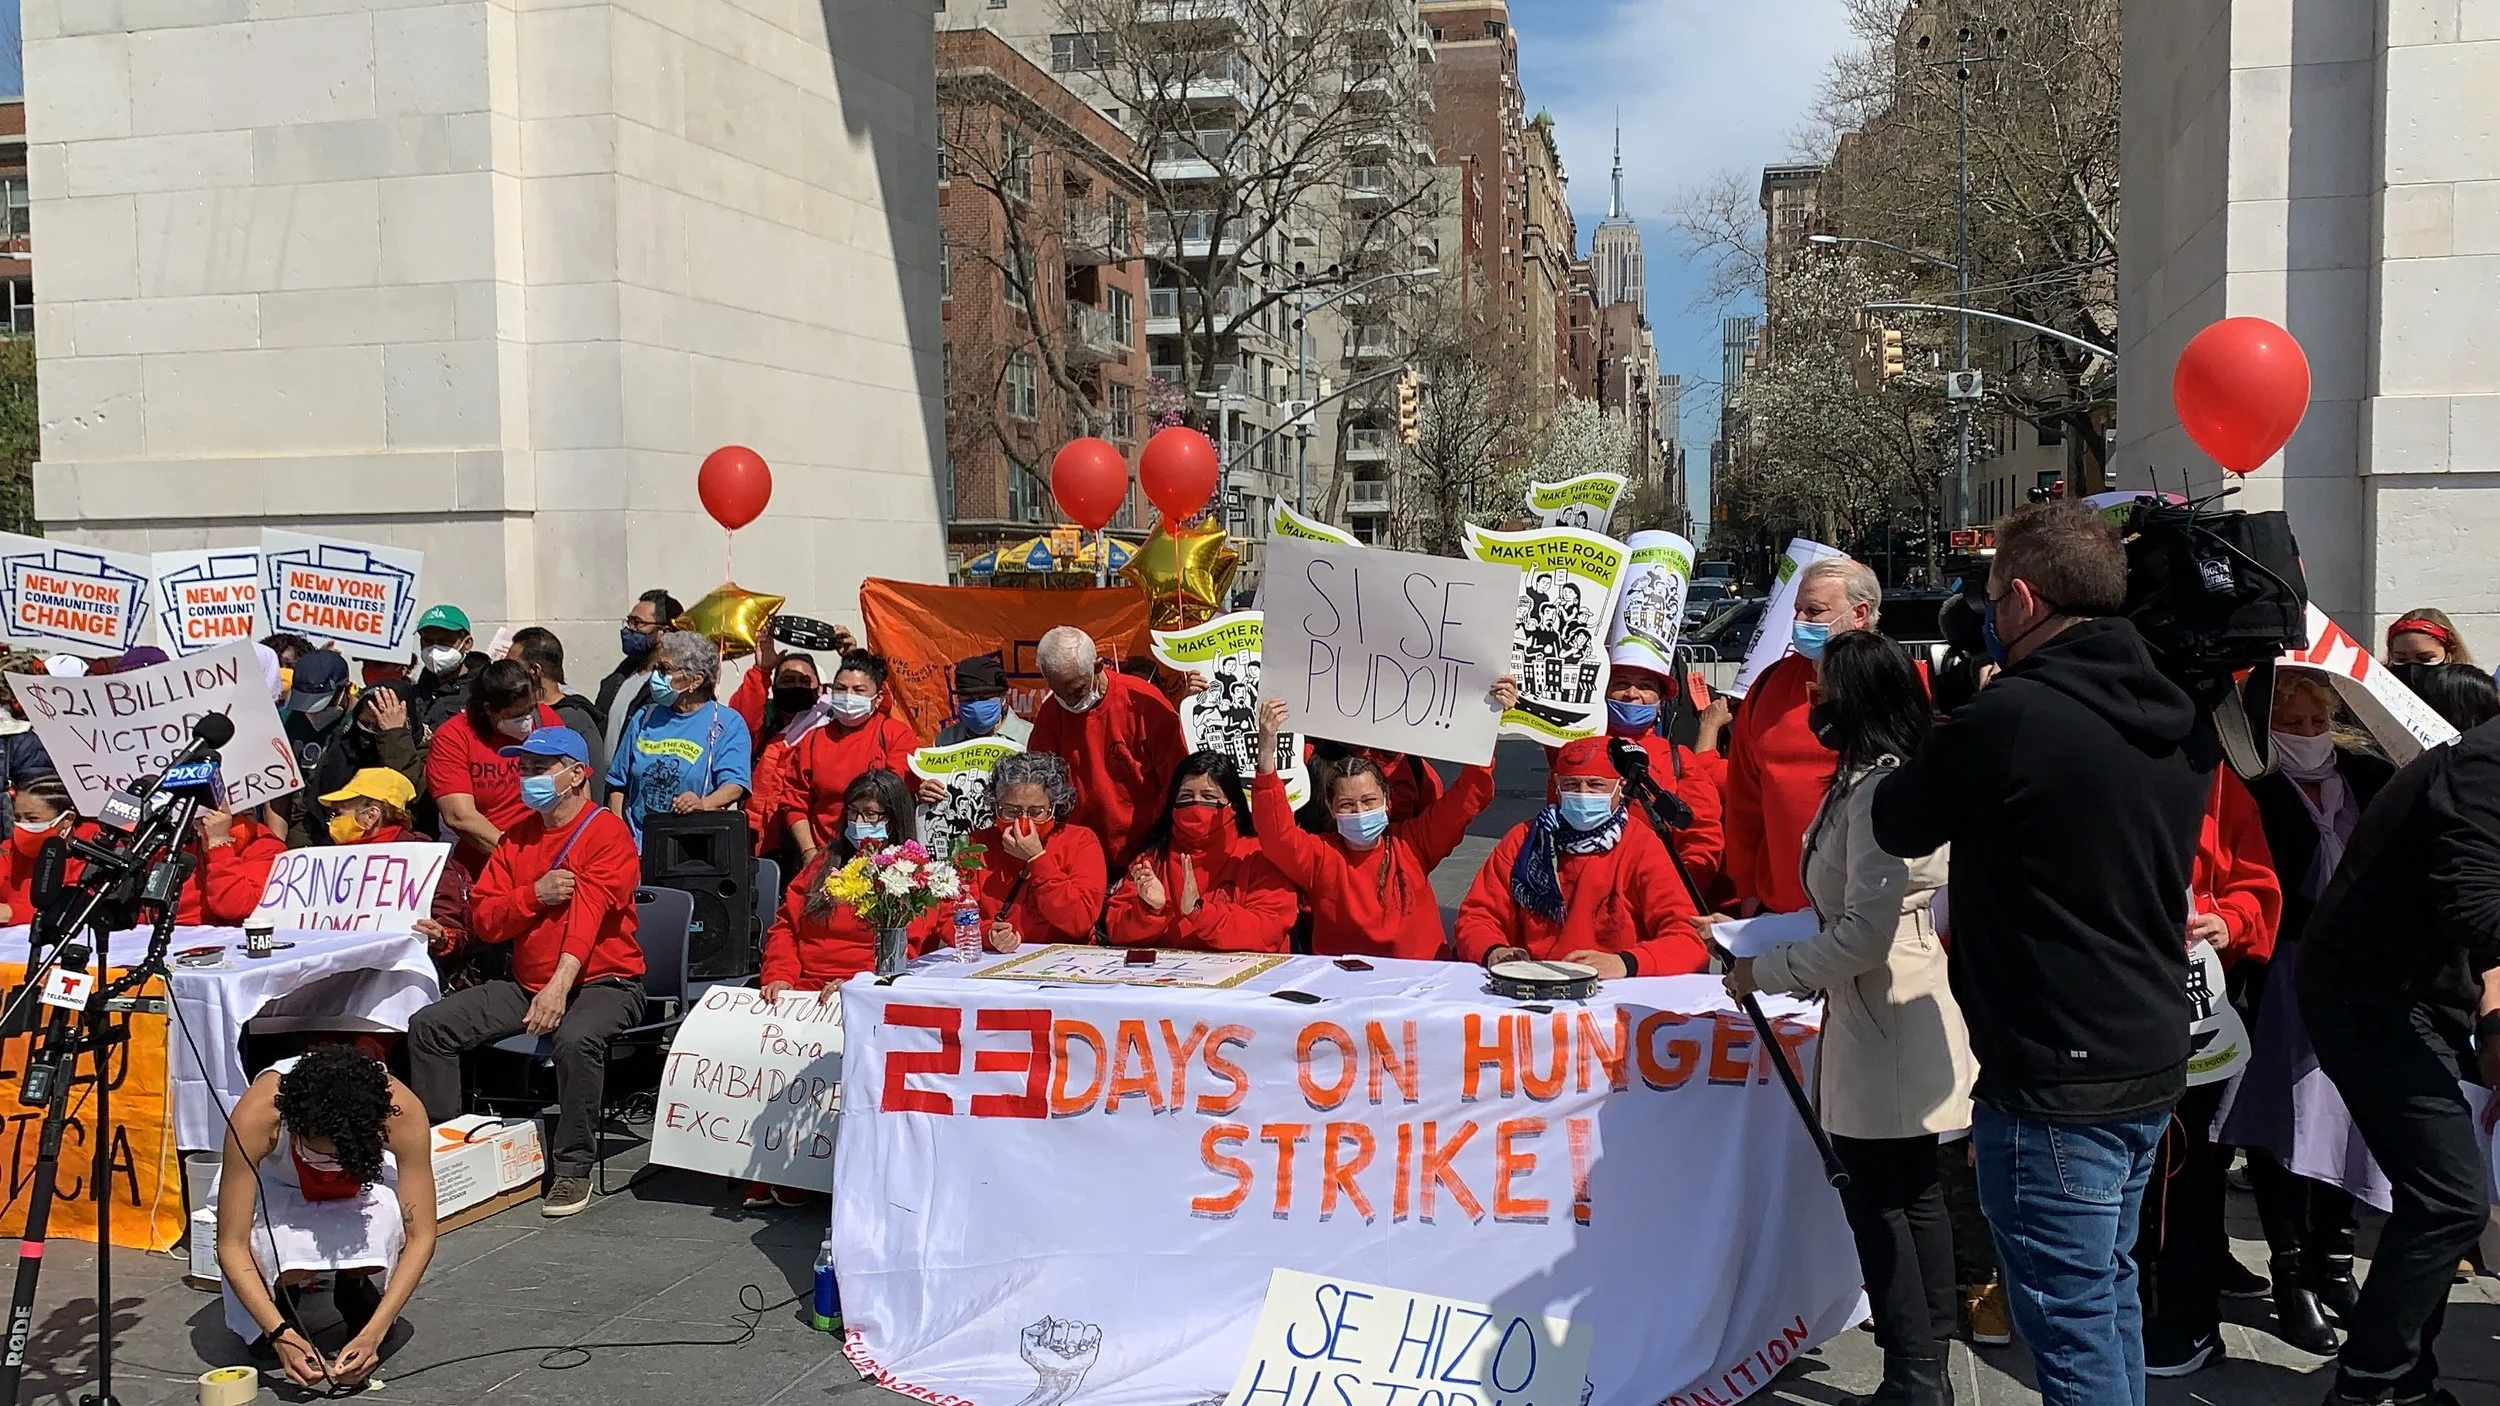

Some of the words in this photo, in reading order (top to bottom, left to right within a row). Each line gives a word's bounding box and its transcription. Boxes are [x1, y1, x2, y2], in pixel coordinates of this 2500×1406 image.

[1541, 488, 1567, 501] MAKE
[1570, 483, 1589, 494] THE
[1590, 481, 1616, 495] ROAD
[1591, 493, 1610, 504] YORK
[1491, 544, 1535, 559] MAKE
[1538, 541, 1569, 555] THE
[1572, 542, 1617, 568] ROAD
[1657, 548, 1677, 557] THE
[1547, 556, 1577, 567] NEW
[1580, 559, 1613, 580] YORK
[25, 574, 68, 594] NEW
[72, 581, 120, 604] YORK
[186, 587, 227, 605] NEW
[290, 571, 334, 592] NEW
[337, 577, 386, 600] YORK
[25, 591, 112, 614] COMMUNITIES
[290, 589, 378, 612] COMMUNITIES
[1303, 559, 1363, 645] SI
[1400, 572, 1475, 665] SE
[21, 602, 118, 637] CHANGE
[286, 602, 384, 635] CHANGE
[1177, 634, 1217, 653] MAKE
[1217, 624, 1247, 641] THE
[1229, 638, 1256, 650] NEW
[103, 656, 238, 718] BILLION
[1305, 638, 1459, 729] PUDO!!
[925, 753, 957, 767] MAKE
[960, 747, 983, 761] THE
[964, 759, 985, 768] NEW
[259, 854, 358, 911] BRING
[356, 855, 443, 912] FEW
[46, 991, 85, 1005] TELEMUNDO
[760, 1022, 824, 1061] Para
[881, 1003, 1052, 1120] 23
[1050, 1018, 1257, 1119] DAYS
[1296, 1019, 1420, 1113] ON
[1461, 1003, 1821, 1103] HUNGER
[2205, 1052, 2233, 1068] PODER
[1190, 1116, 1593, 1227] STRIKE!
[1286, 1283, 1374, 1364] SE
[1389, 1297, 1537, 1394] HIZO
